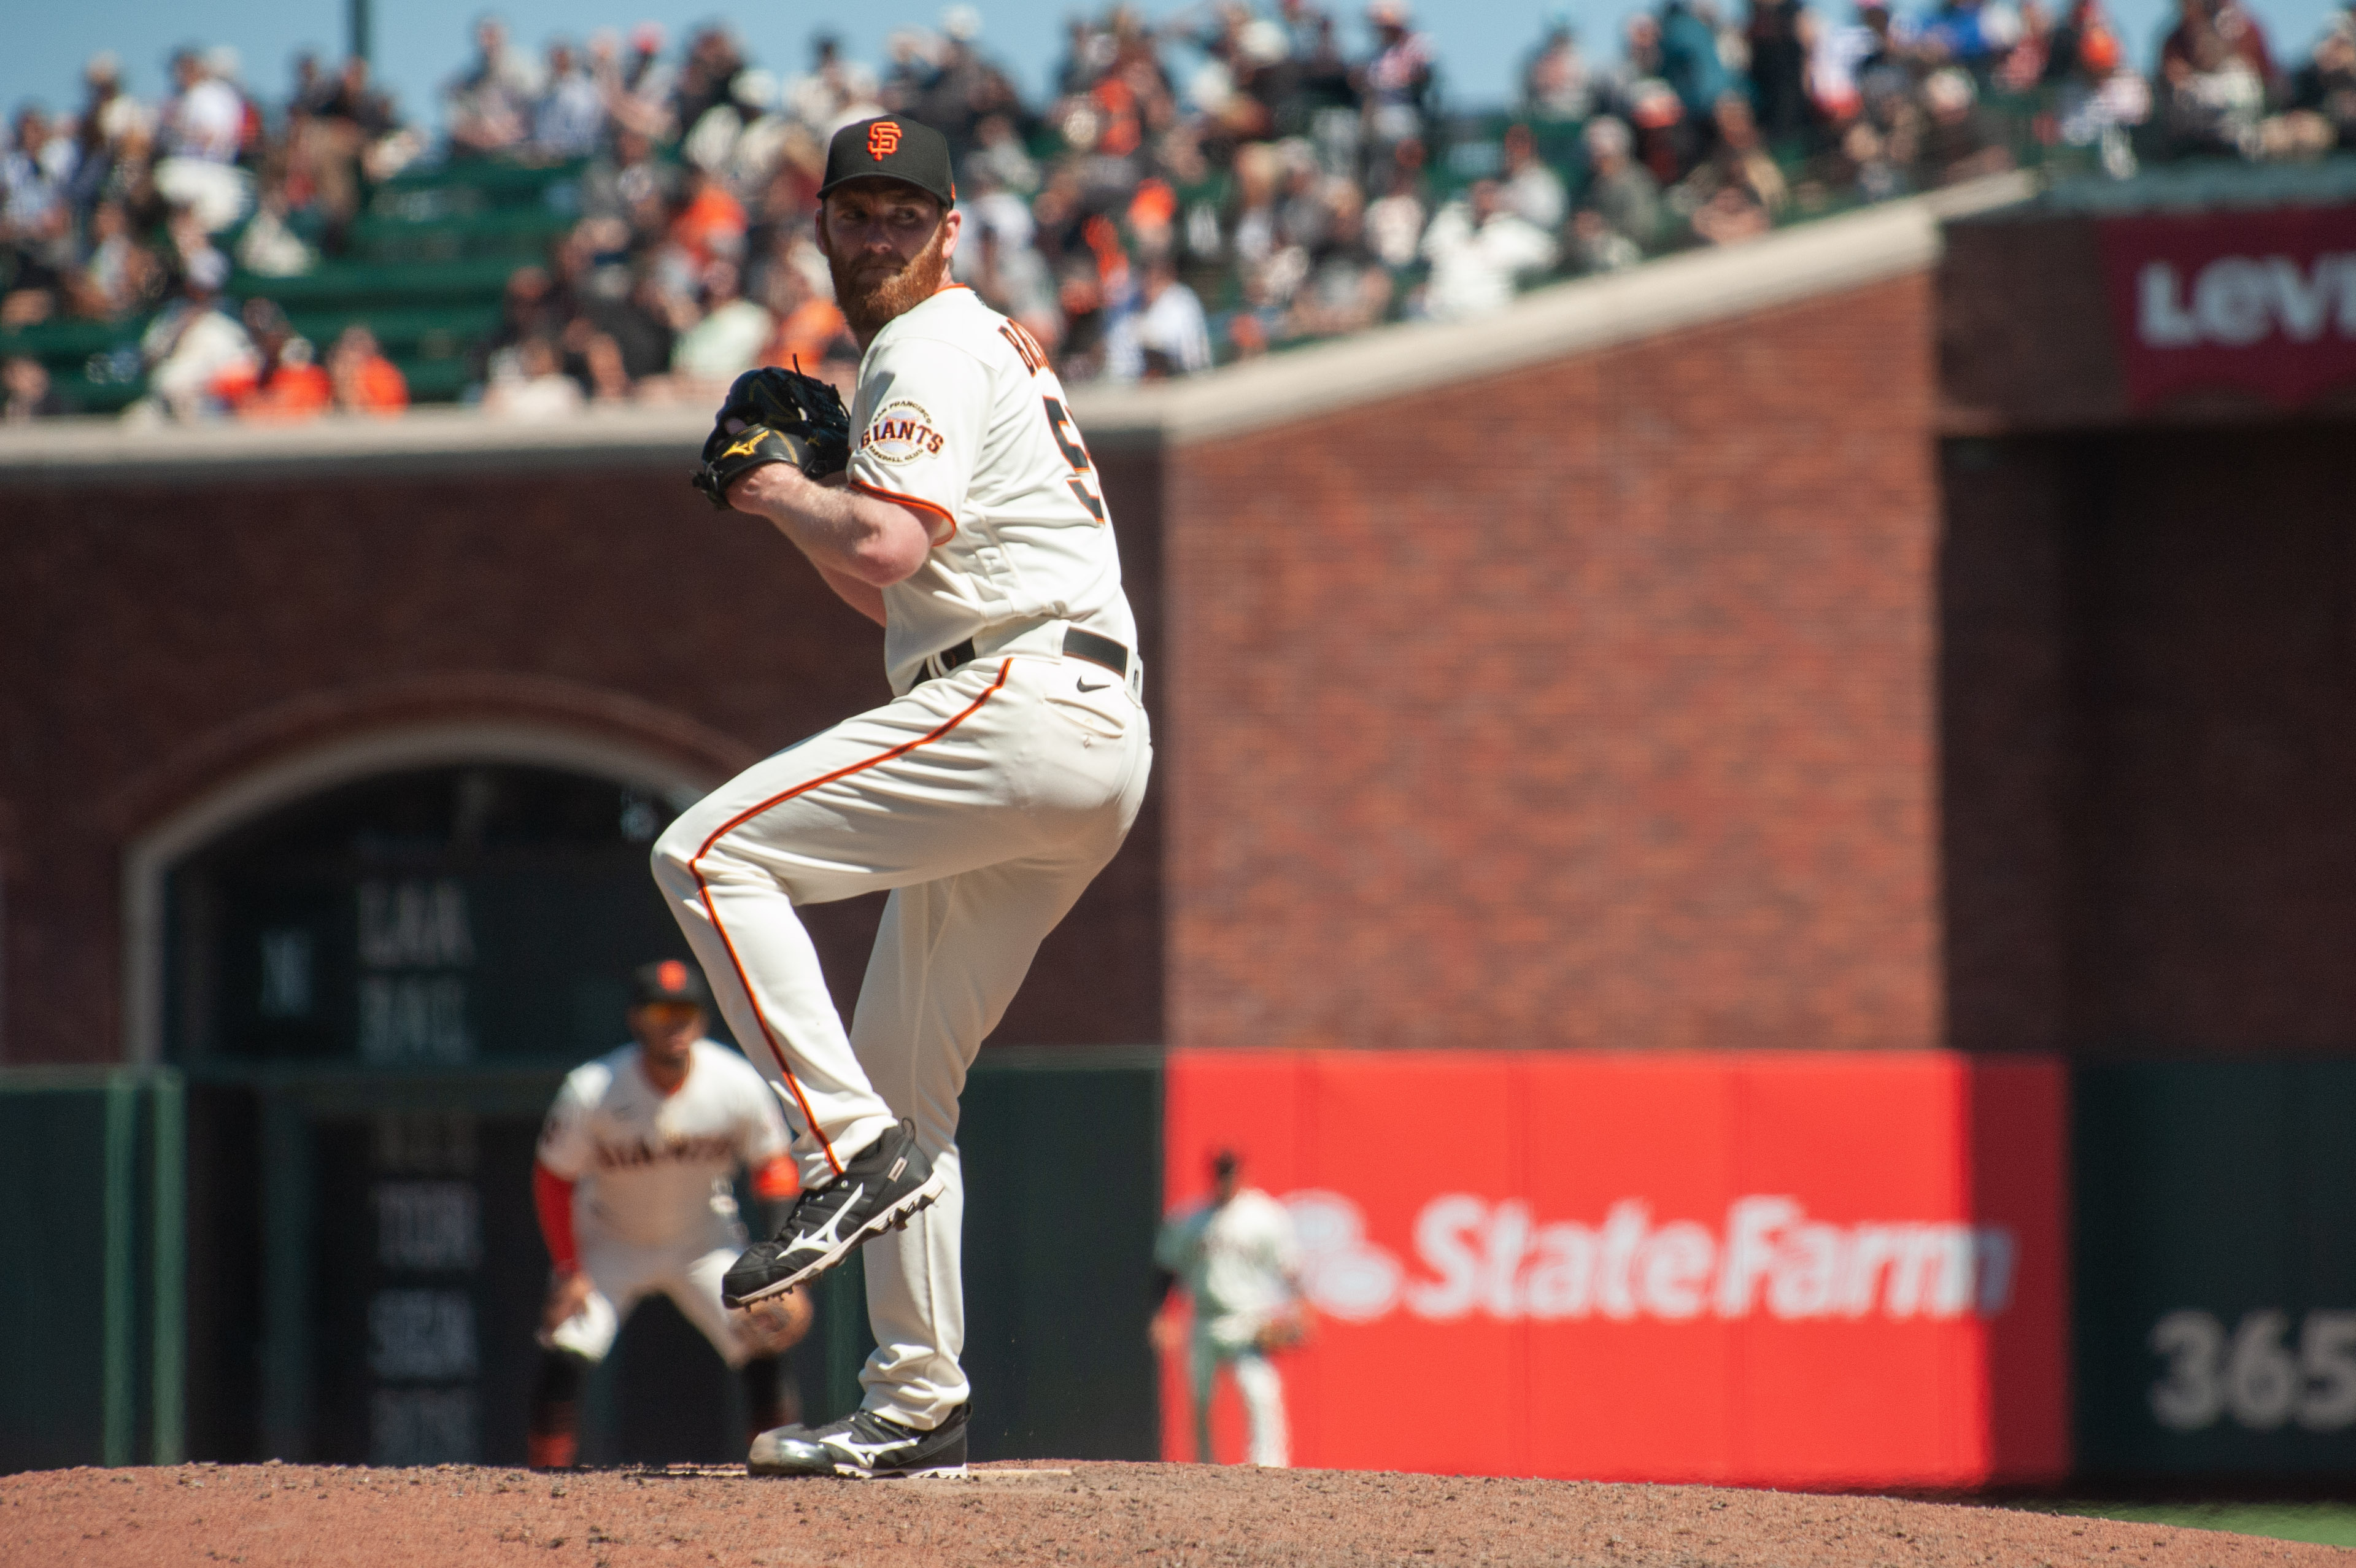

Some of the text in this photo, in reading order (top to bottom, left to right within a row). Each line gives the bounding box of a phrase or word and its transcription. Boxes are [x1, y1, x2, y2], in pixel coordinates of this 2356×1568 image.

[867, 122, 903, 161] SF
[889, 400, 931, 423] FRANCISCO
[860, 420, 943, 454] GIANTS
[868, 444, 924, 462] BASEBALL CLUB
[2149, 1308, 2356, 1433] 365
